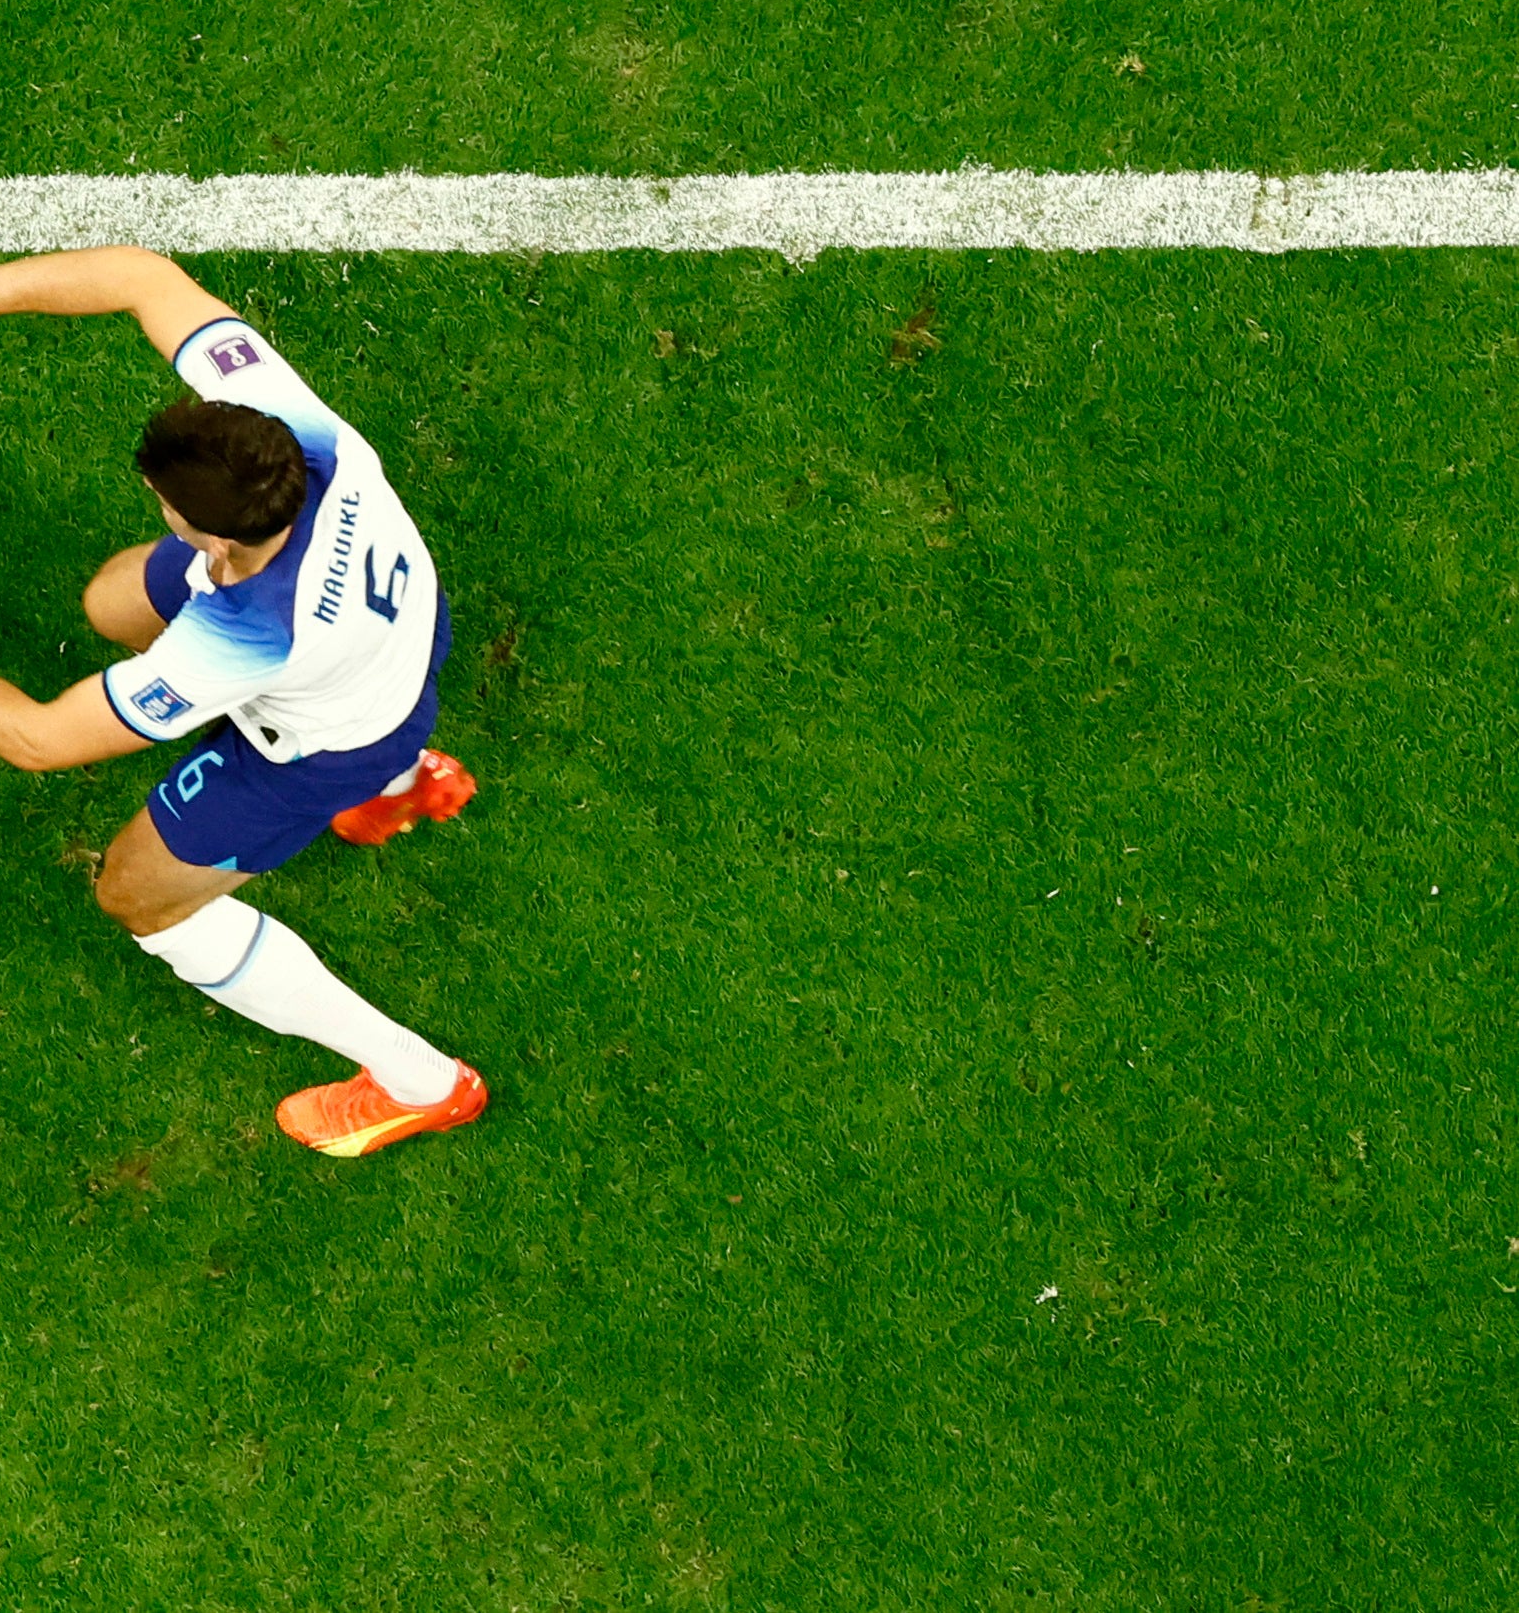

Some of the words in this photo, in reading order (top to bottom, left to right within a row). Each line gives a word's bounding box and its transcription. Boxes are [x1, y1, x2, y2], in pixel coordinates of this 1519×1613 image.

[313, 490, 360, 625] MAGUIRE
[364, 544, 410, 624] 6
[176, 750, 225, 803] 6
